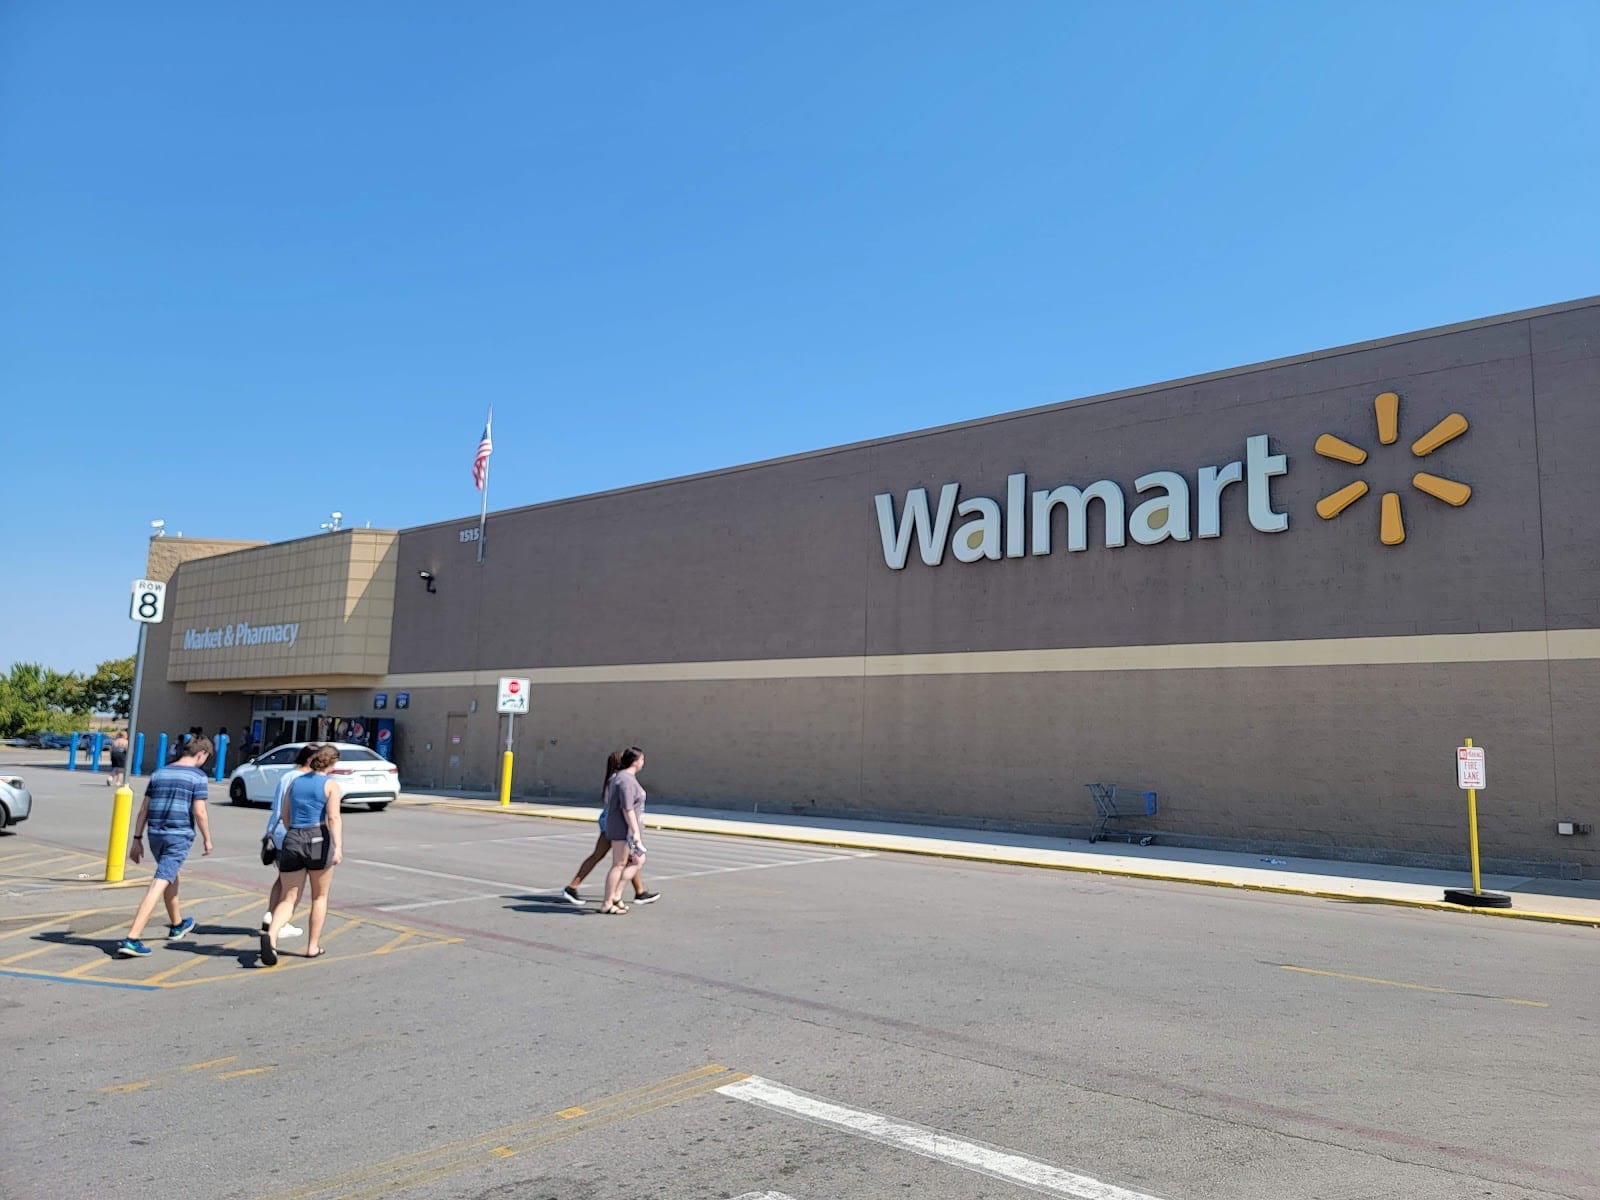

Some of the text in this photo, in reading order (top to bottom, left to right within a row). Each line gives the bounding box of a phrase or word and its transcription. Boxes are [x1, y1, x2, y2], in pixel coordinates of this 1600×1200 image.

[874, 434, 1289, 570] Walmart
[139, 582, 163, 591] ROW
[139, 592, 157, 618] 8
[183, 622, 299, 650] Market & Pharmacy
[1464, 761, 1478, 770] FIRE
[1464, 771, 1480, 780] LANE
